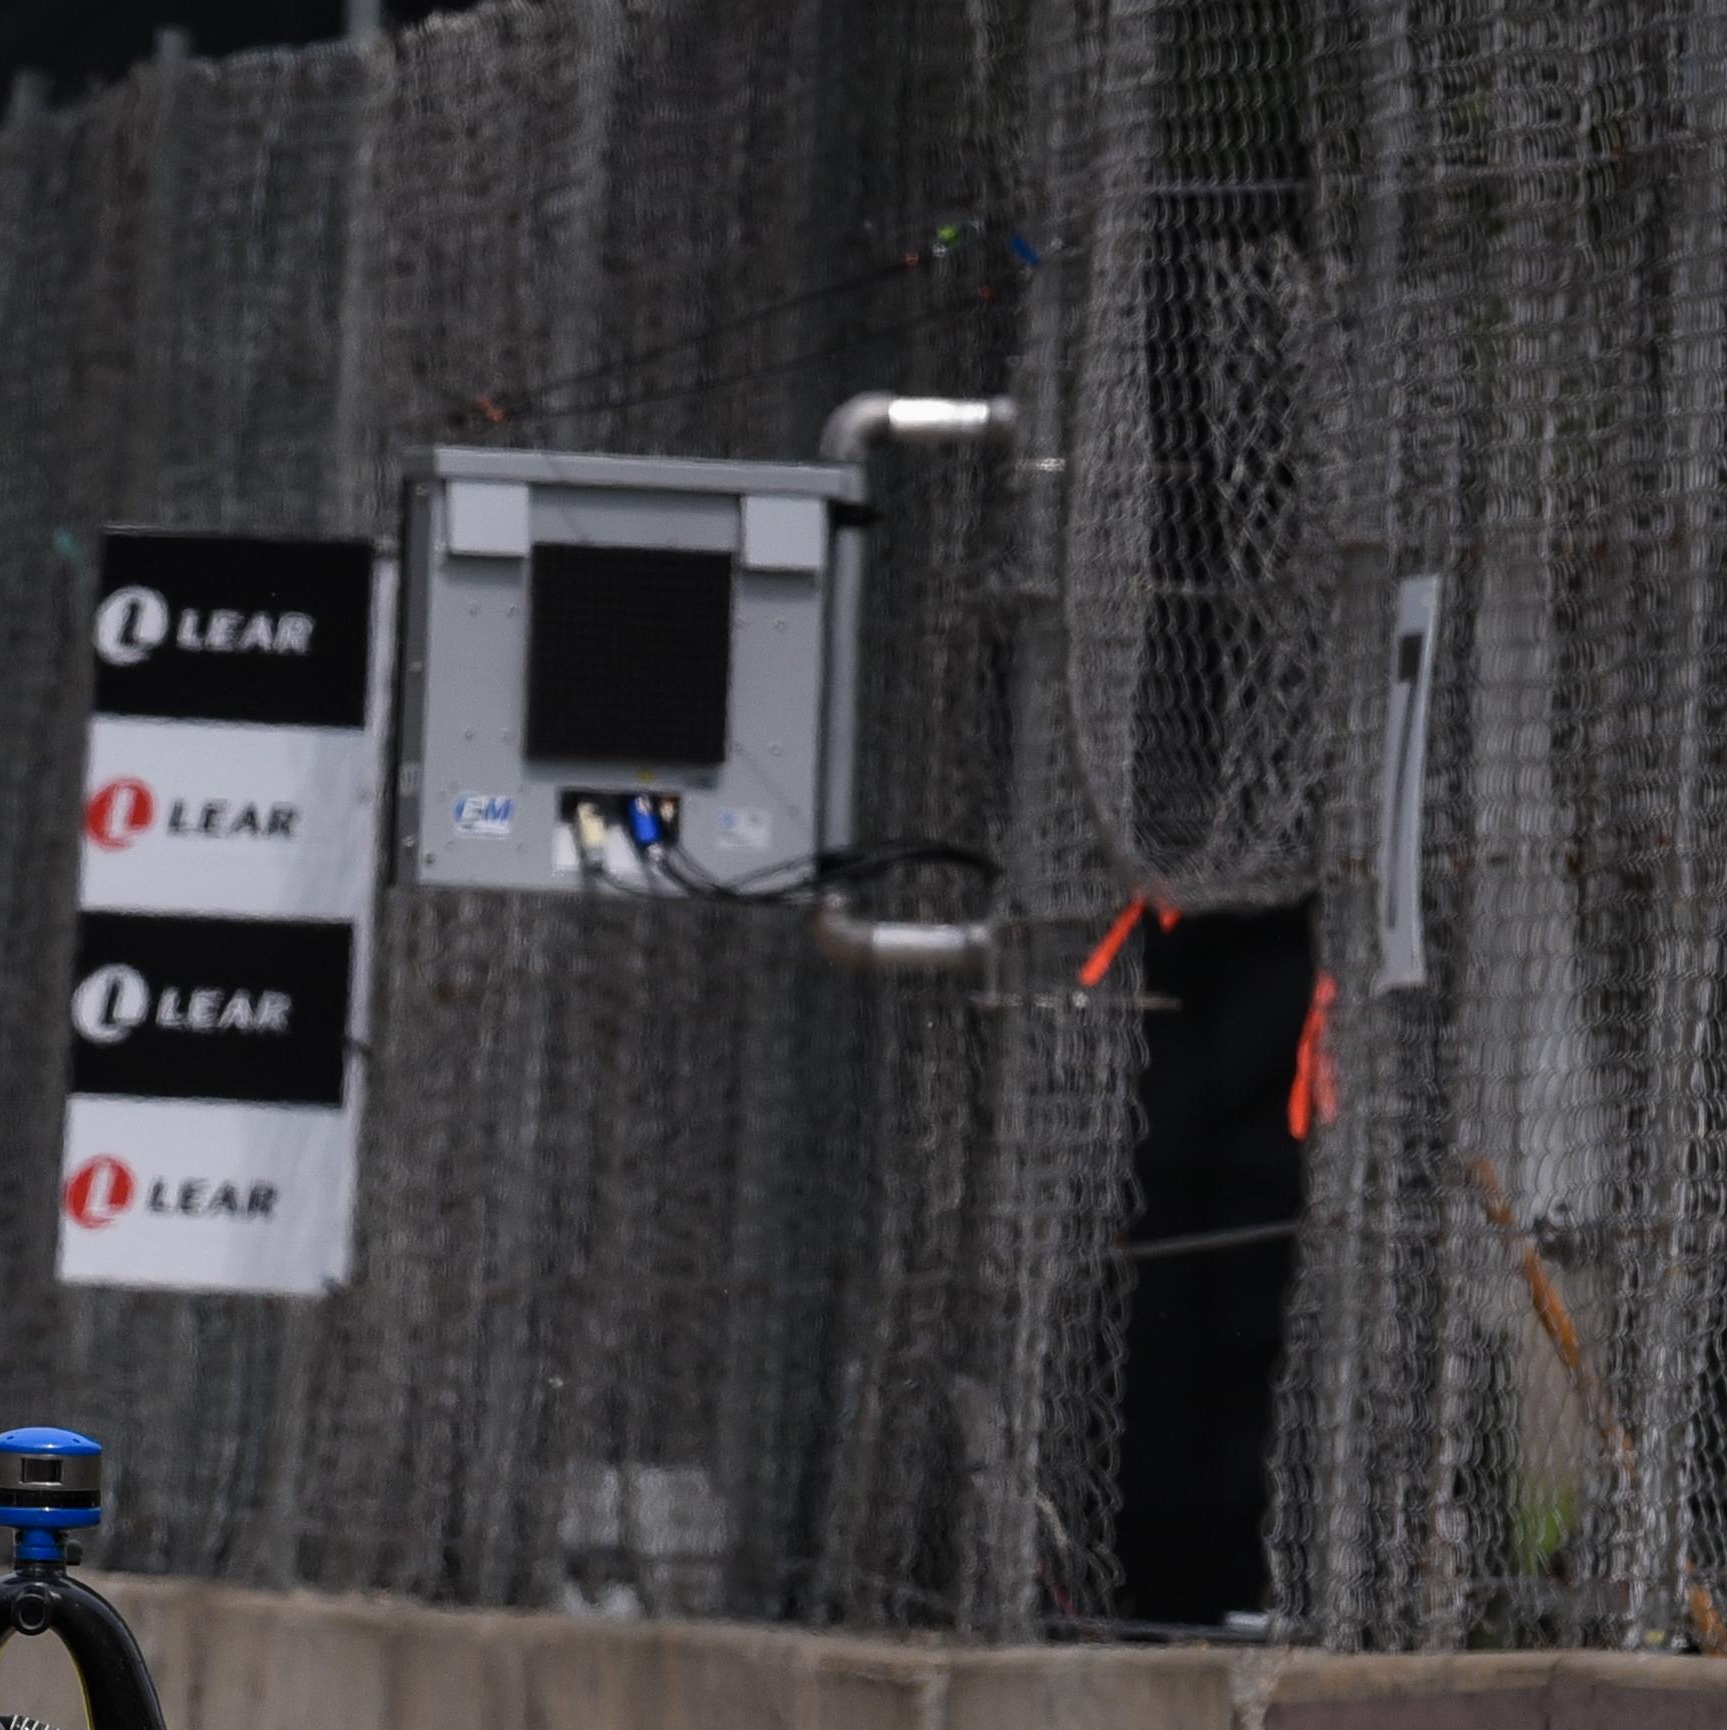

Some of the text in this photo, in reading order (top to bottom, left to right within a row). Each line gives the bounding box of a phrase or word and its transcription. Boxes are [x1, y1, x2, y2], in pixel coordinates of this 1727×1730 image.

[176, 608, 315, 655] LEAR
[166, 798, 300, 840] LEAR
[155, 985, 292, 1033] LEAR
[146, 1173, 279, 1220] LEAR
